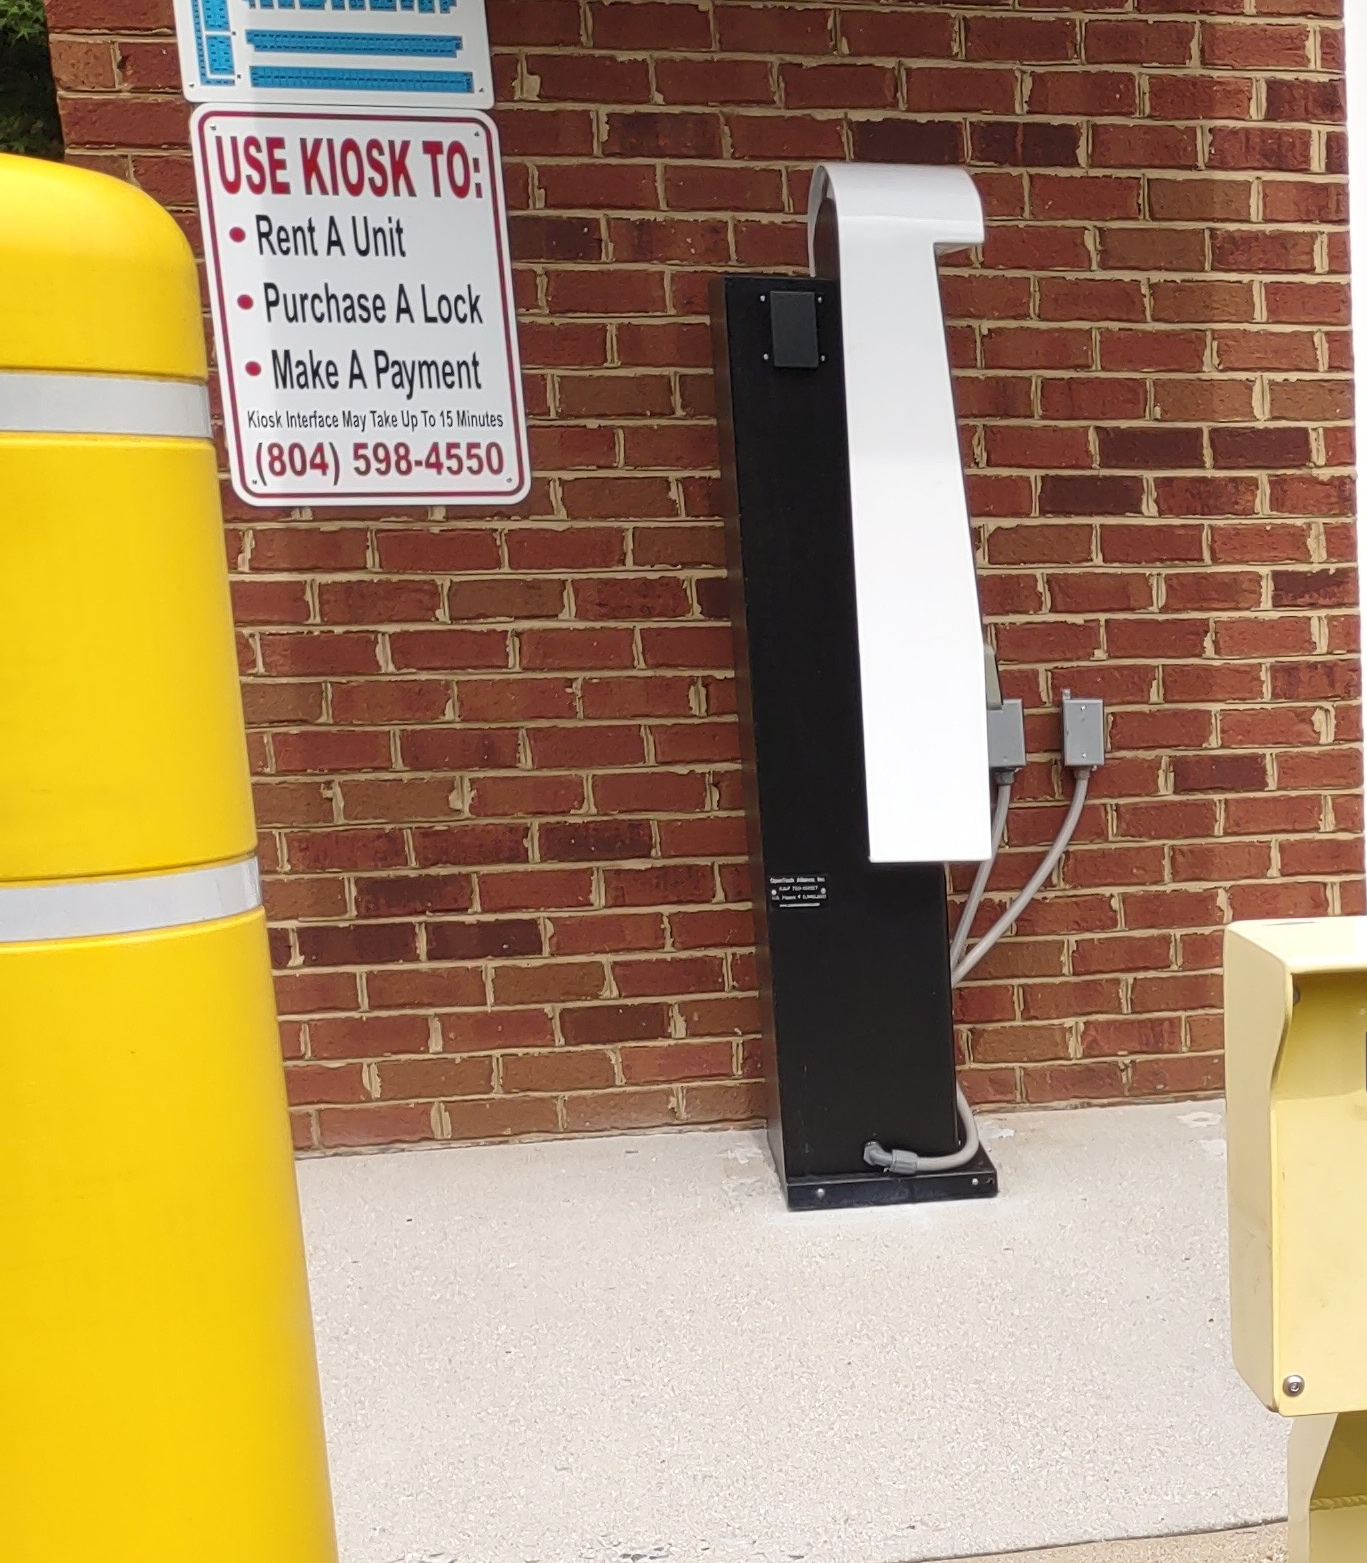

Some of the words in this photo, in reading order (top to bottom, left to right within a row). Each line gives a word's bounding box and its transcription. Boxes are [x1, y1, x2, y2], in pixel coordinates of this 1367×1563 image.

[215, 135, 291, 195] USE
[300, 137, 417, 197] KIOSK
[422, 140, 483, 199] TO:
[255, 214, 318, 256] Rent
[326, 215, 345, 256] A
[352, 215, 406, 257] Unit
[263, 282, 386, 324] Purchase
[396, 283, 415, 324] A
[421, 283, 483, 324] Lock
[271, 349, 339, 389] Make
[348, 349, 367, 389] A
[373, 349, 482, 400] Payment
[247, 411, 282, 429] Kiosk
[286, 411, 339, 428] Interface
[342, 411, 366, 432] May
[369, 411, 398, 428] Take
[401, 411, 418, 432] Up
[421, 410, 436, 428] To
[440, 411, 453, 428] 15
[457, 410, 504, 428] Minutes
[256, 441, 340, 487] (804)
[353, 441, 504, 476] 598-4550
